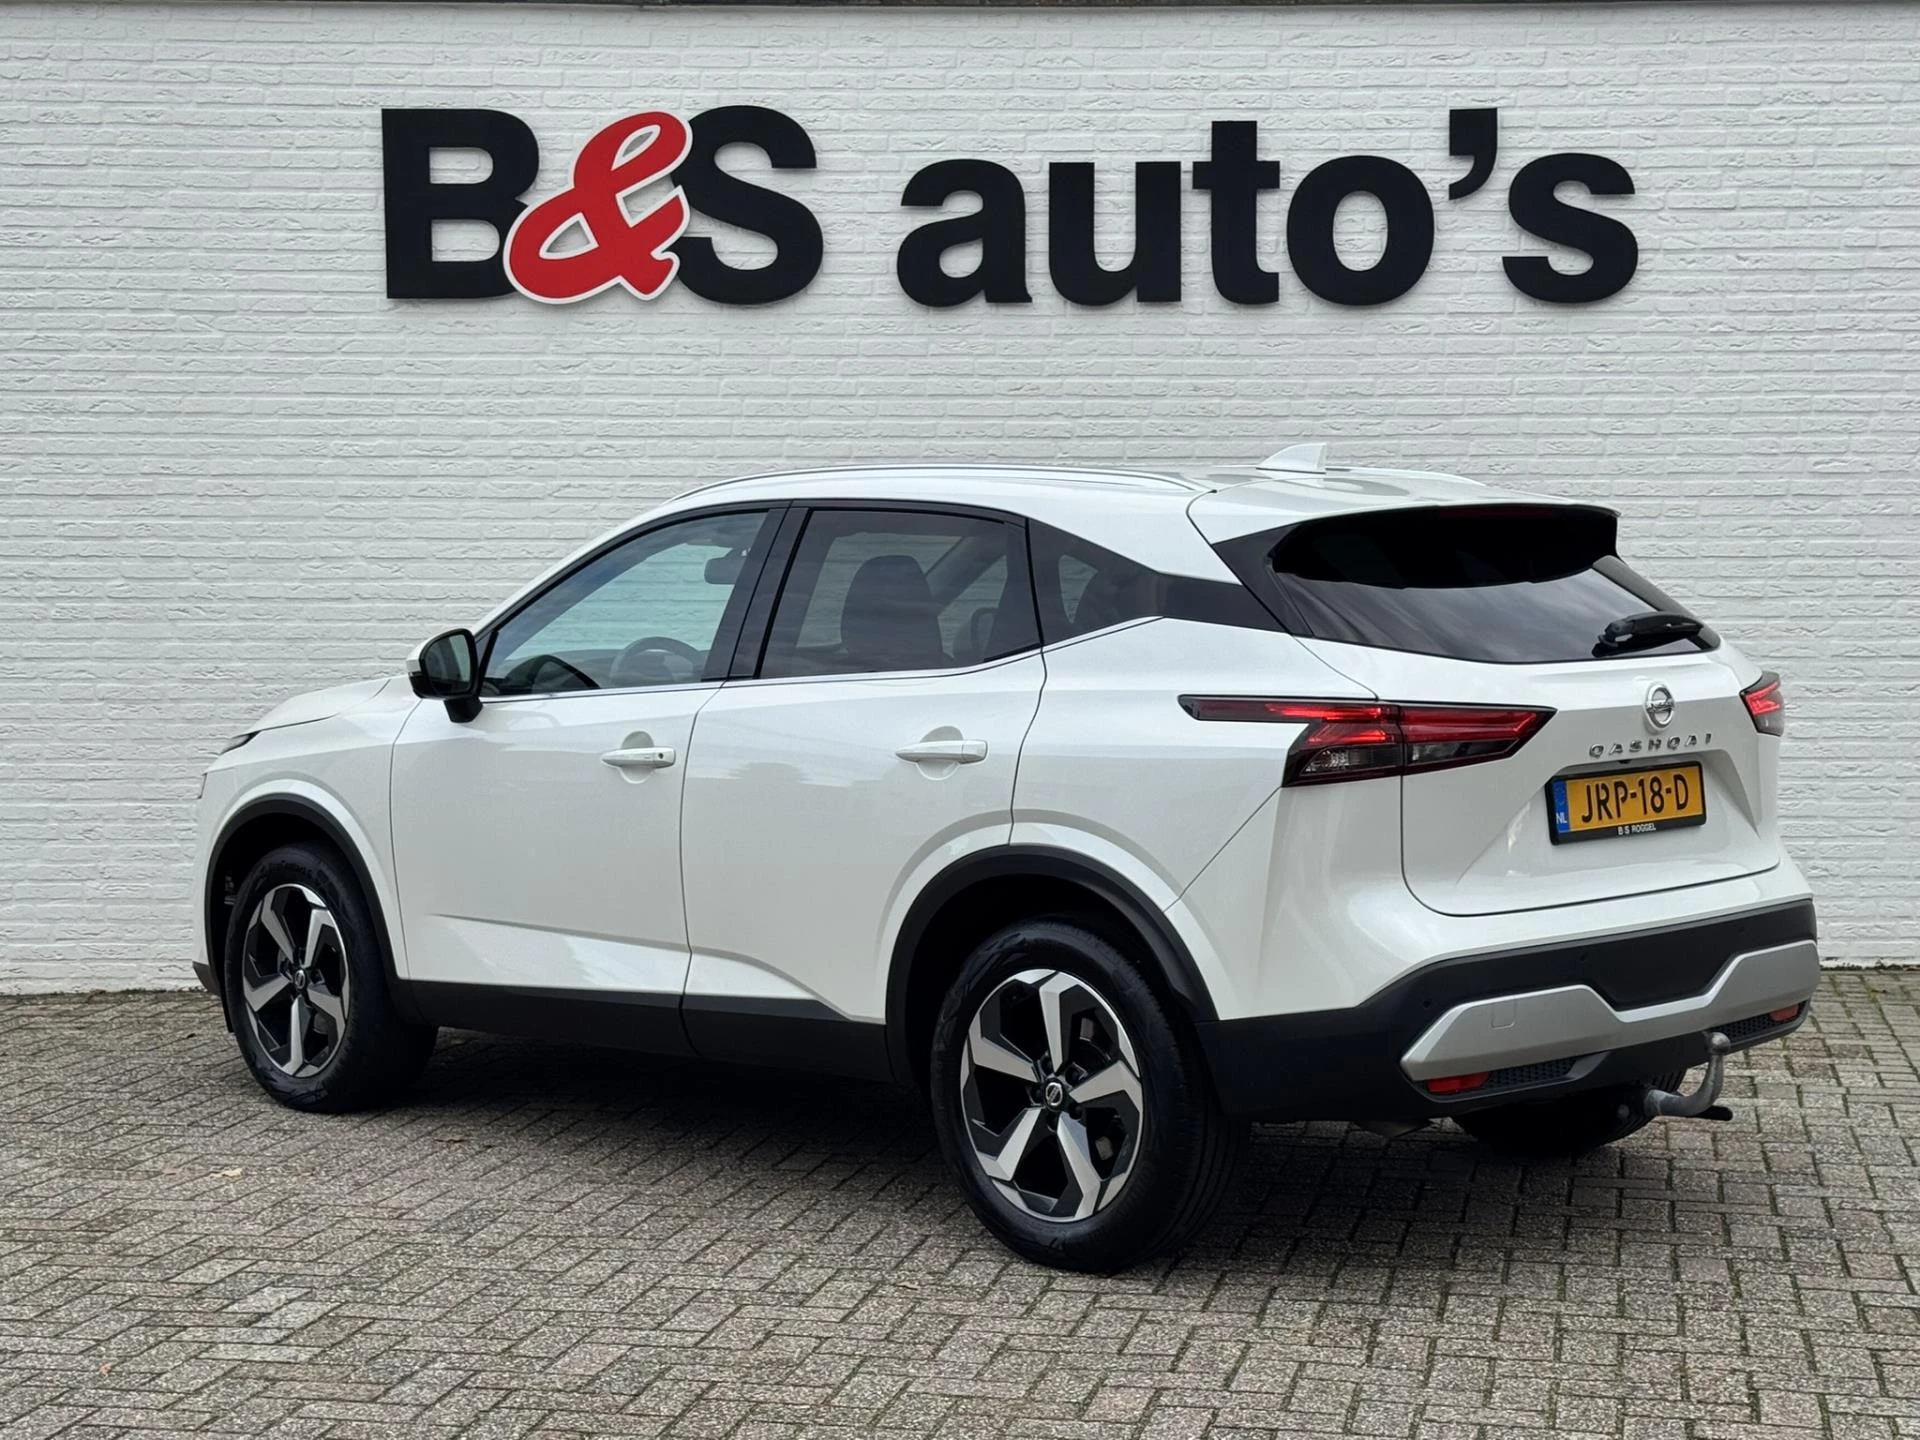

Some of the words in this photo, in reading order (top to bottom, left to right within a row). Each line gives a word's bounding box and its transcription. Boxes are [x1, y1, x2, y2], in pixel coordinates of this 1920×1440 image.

[382, 106, 823, 306] B&S
[897, 108, 1638, 308] auto's
[1589, 733, 1712, 757] QASHQAI
[1581, 773, 1689, 823] JRP-18-D
[1556, 812, 1568, 824] NL
